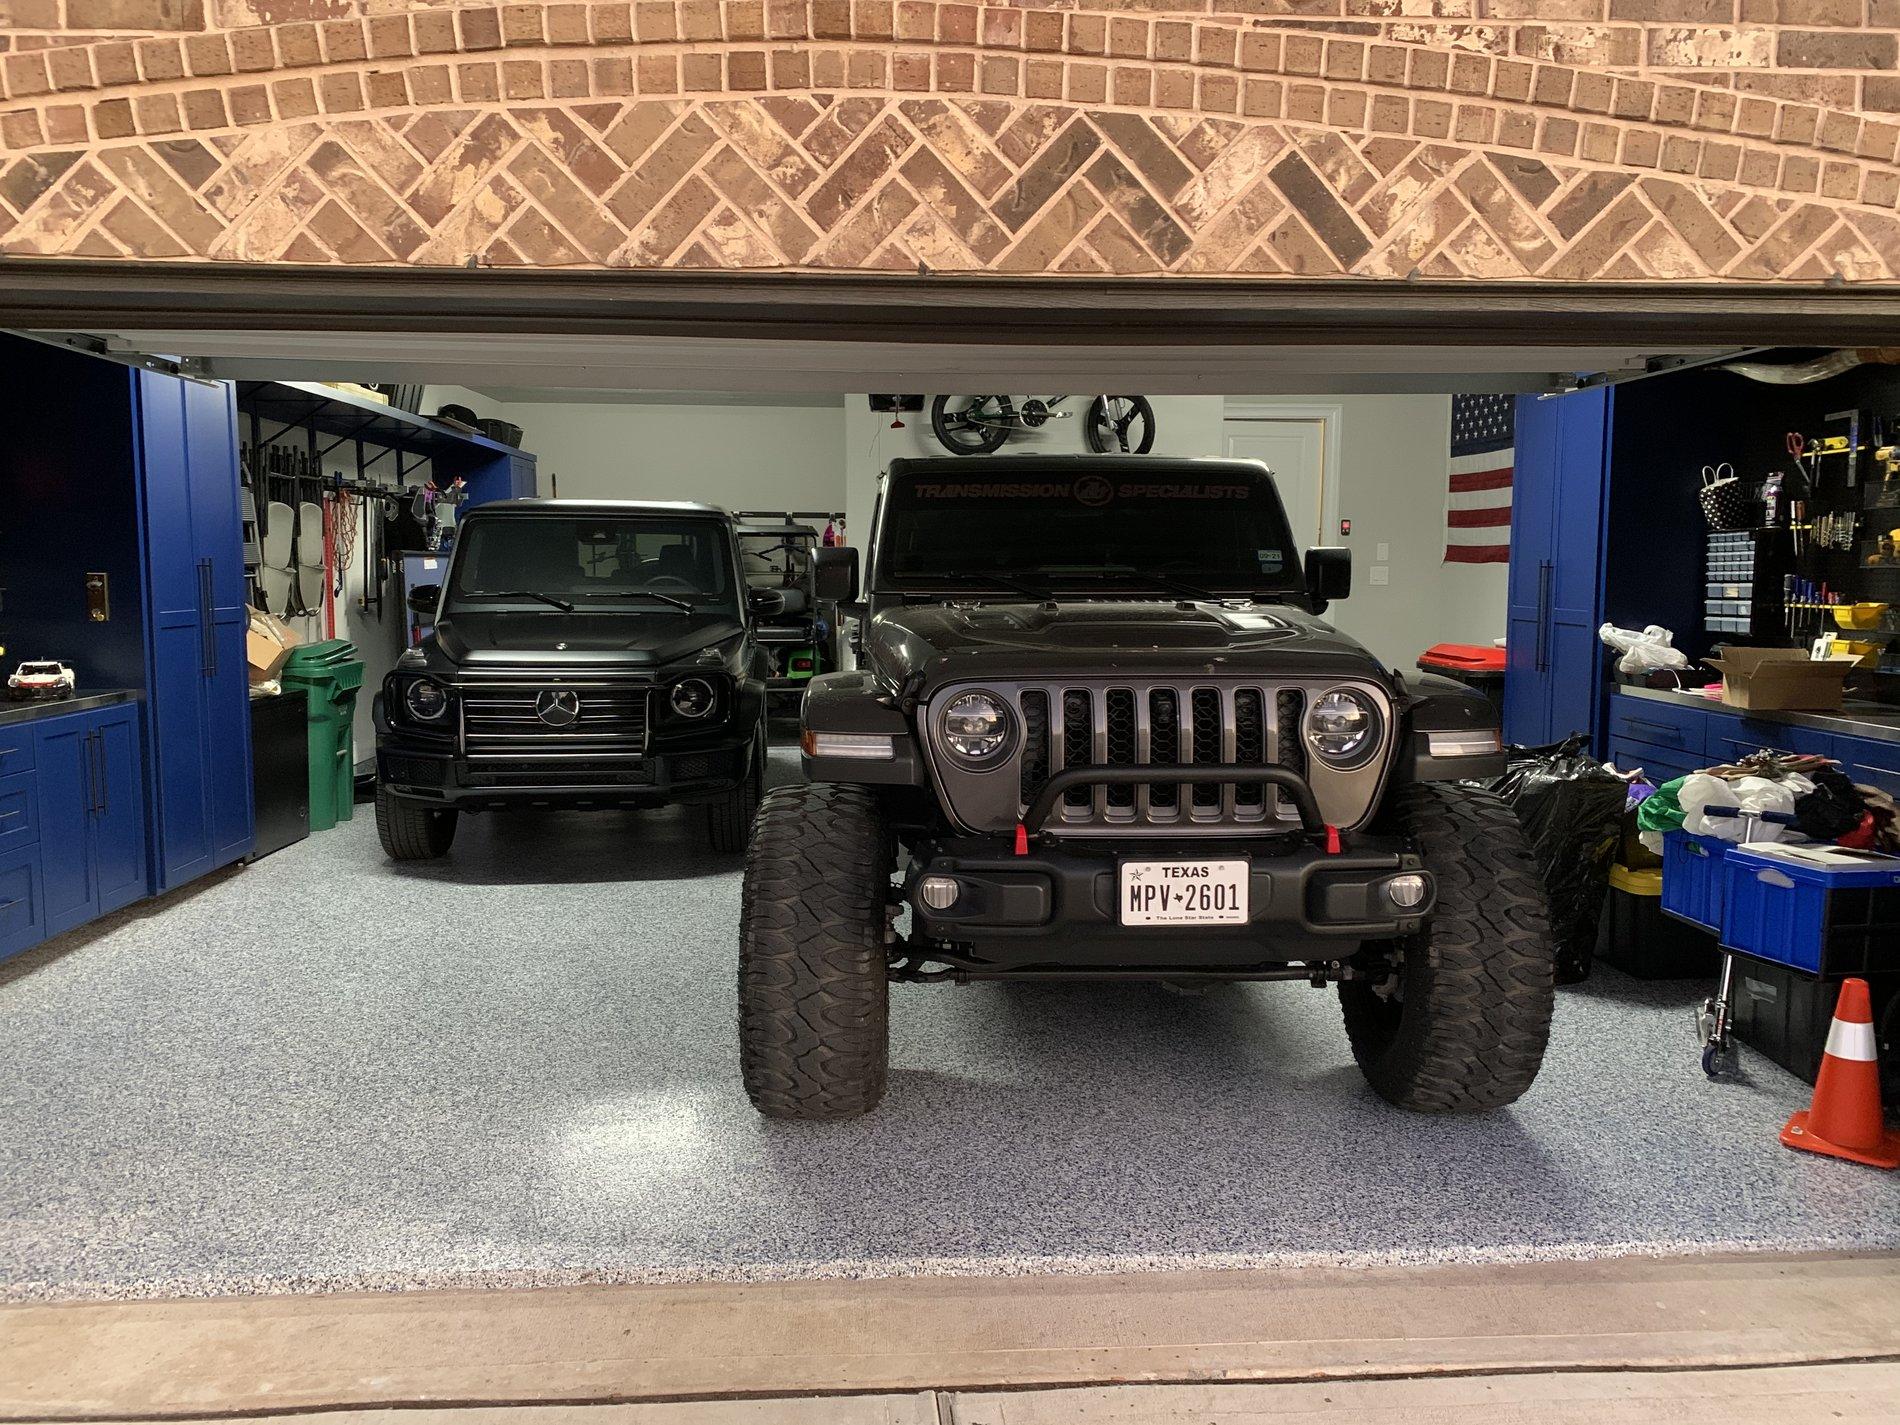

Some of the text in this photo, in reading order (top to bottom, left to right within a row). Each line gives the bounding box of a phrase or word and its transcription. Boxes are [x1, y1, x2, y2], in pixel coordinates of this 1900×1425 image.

[914, 483, 1072, 498] TRANSMISSION
[1118, 484, 1249, 499] SPECIALISTS
[1162, 867, 1209, 878] TEXAS
[1130, 884, 1239, 911] MPV 2601
